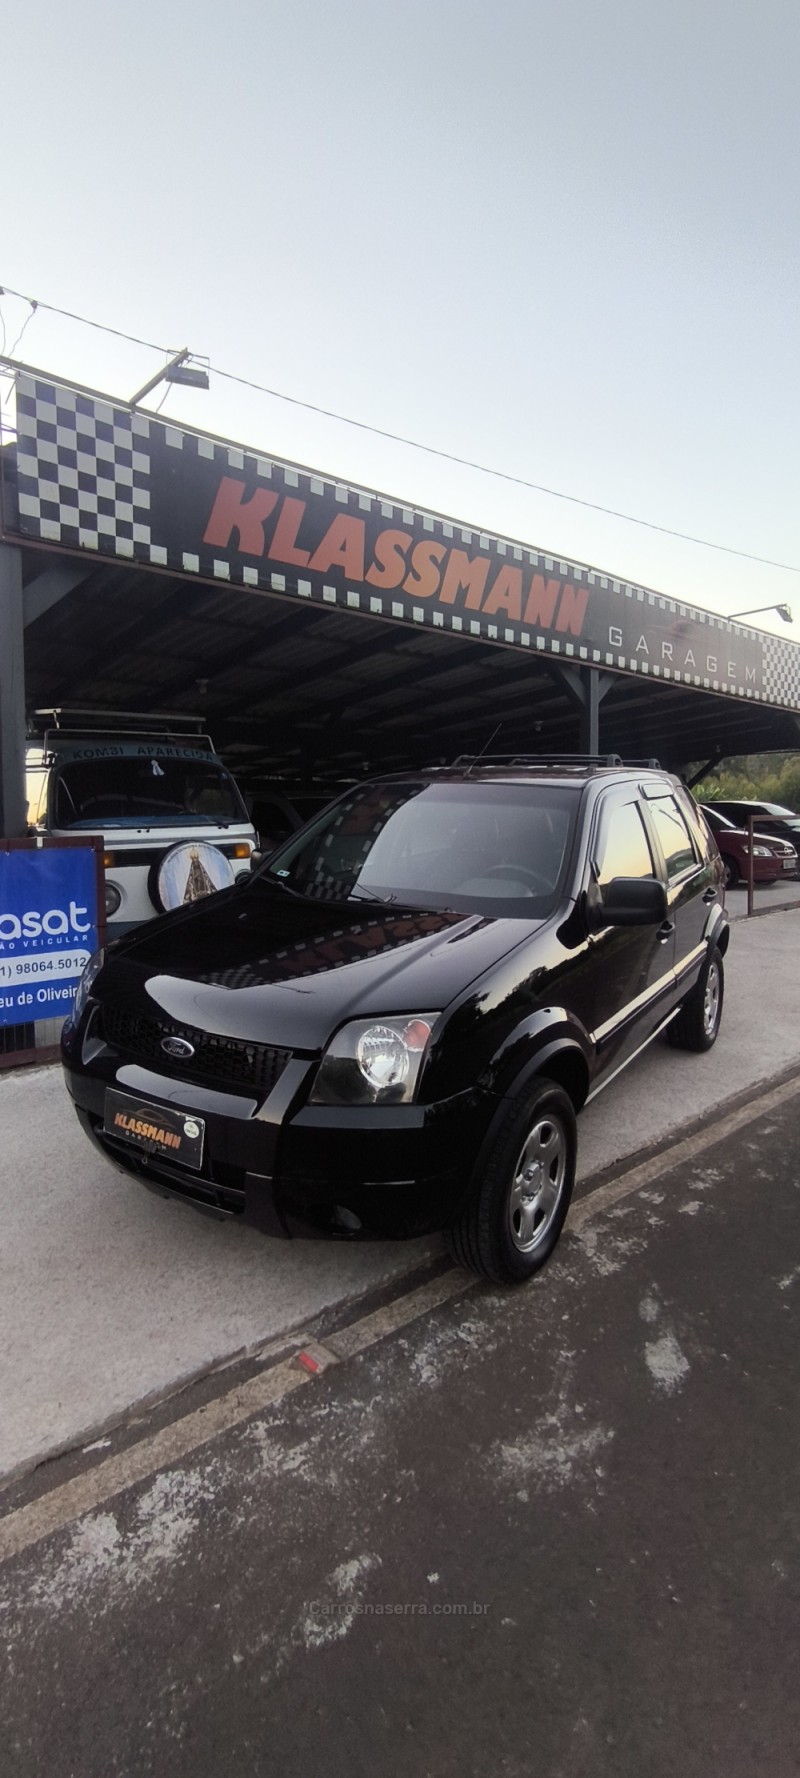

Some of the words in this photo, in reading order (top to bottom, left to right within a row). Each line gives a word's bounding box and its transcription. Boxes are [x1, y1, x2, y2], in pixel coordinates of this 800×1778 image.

[203, 476, 589, 637] KLASSMANN
[608, 626, 757, 683] GARAGEM
[72, 746, 124, 760] KOMBI
[137, 745, 214, 761] APARECIDA
[23, 934, 88, 947] VEICULAR
[16, 957, 87, 974] 98064.5012
[17, 991, 33, 1005] de
[114, 1112, 181, 1149] KLASSMANN
